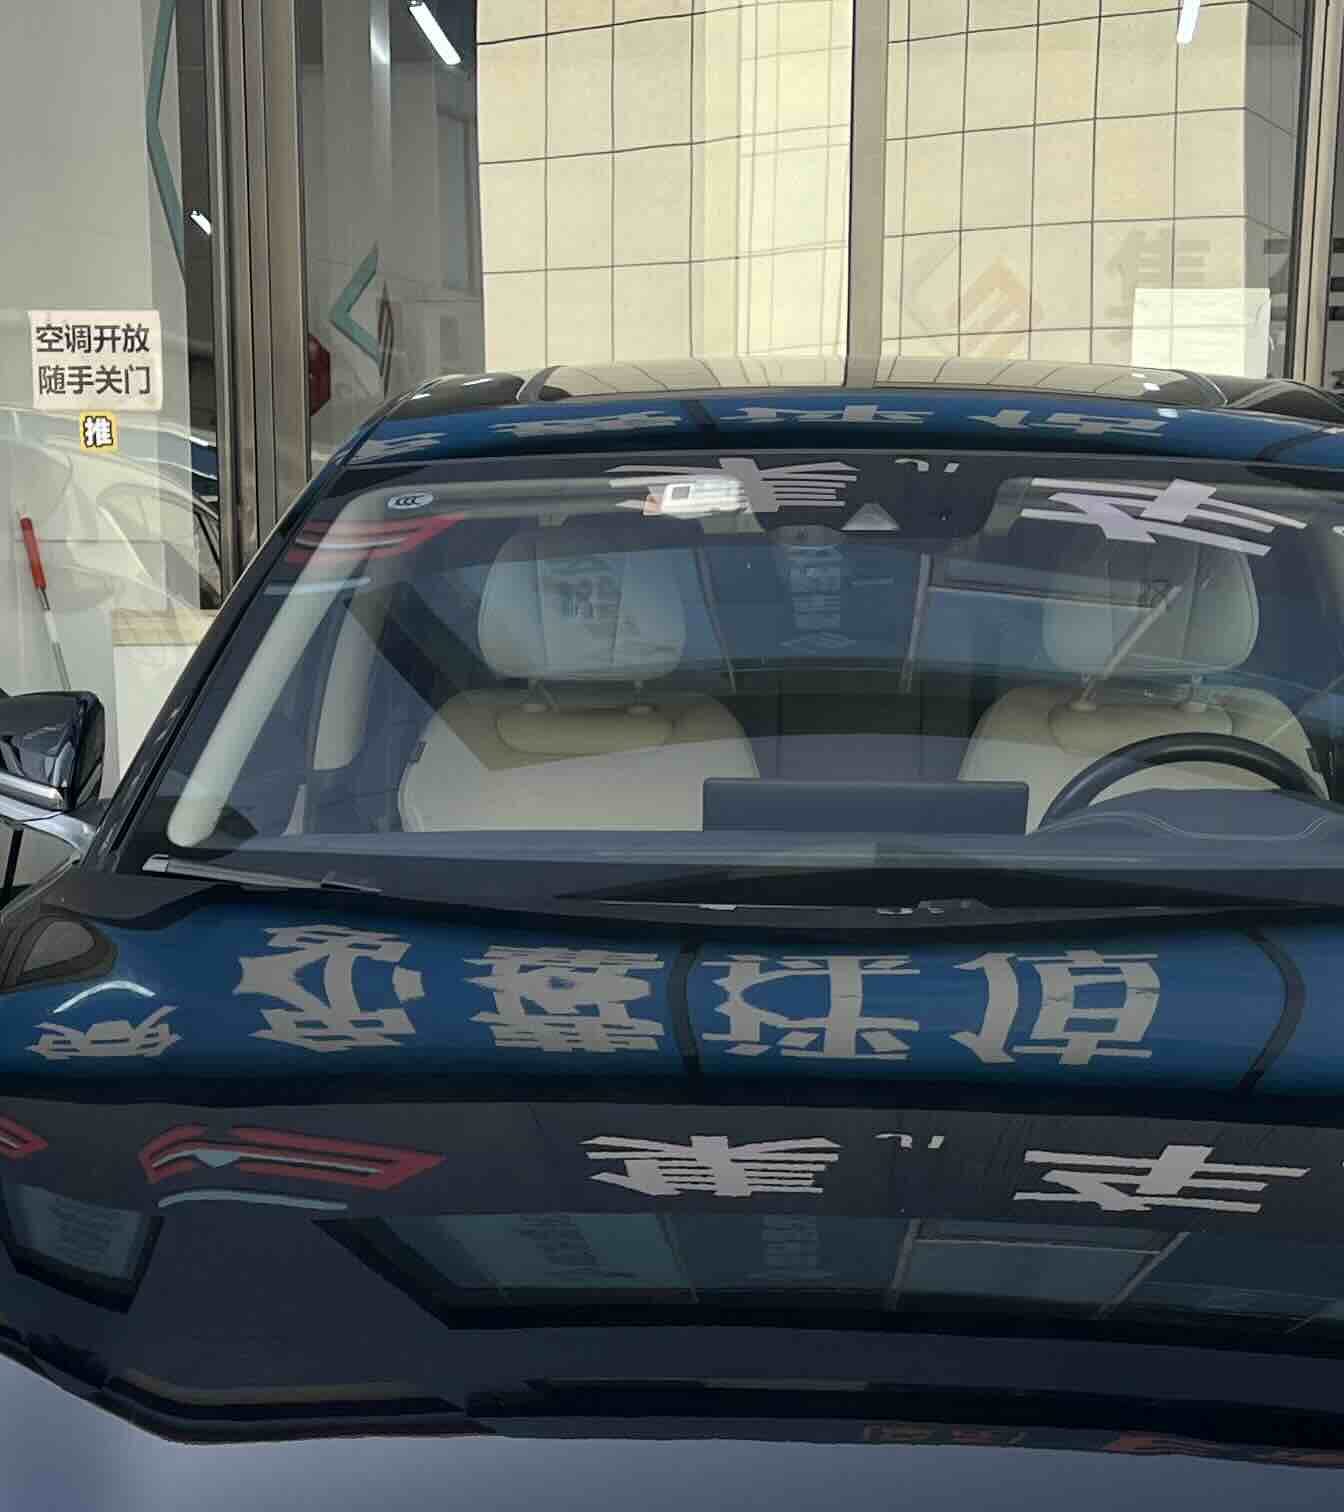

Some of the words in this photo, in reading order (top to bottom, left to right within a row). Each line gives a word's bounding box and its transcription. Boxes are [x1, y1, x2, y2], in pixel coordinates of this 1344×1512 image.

[36, 324, 150, 353] 空调开放
[38, 365, 151, 395] 随手关门
[83, 416, 114, 448] 推
